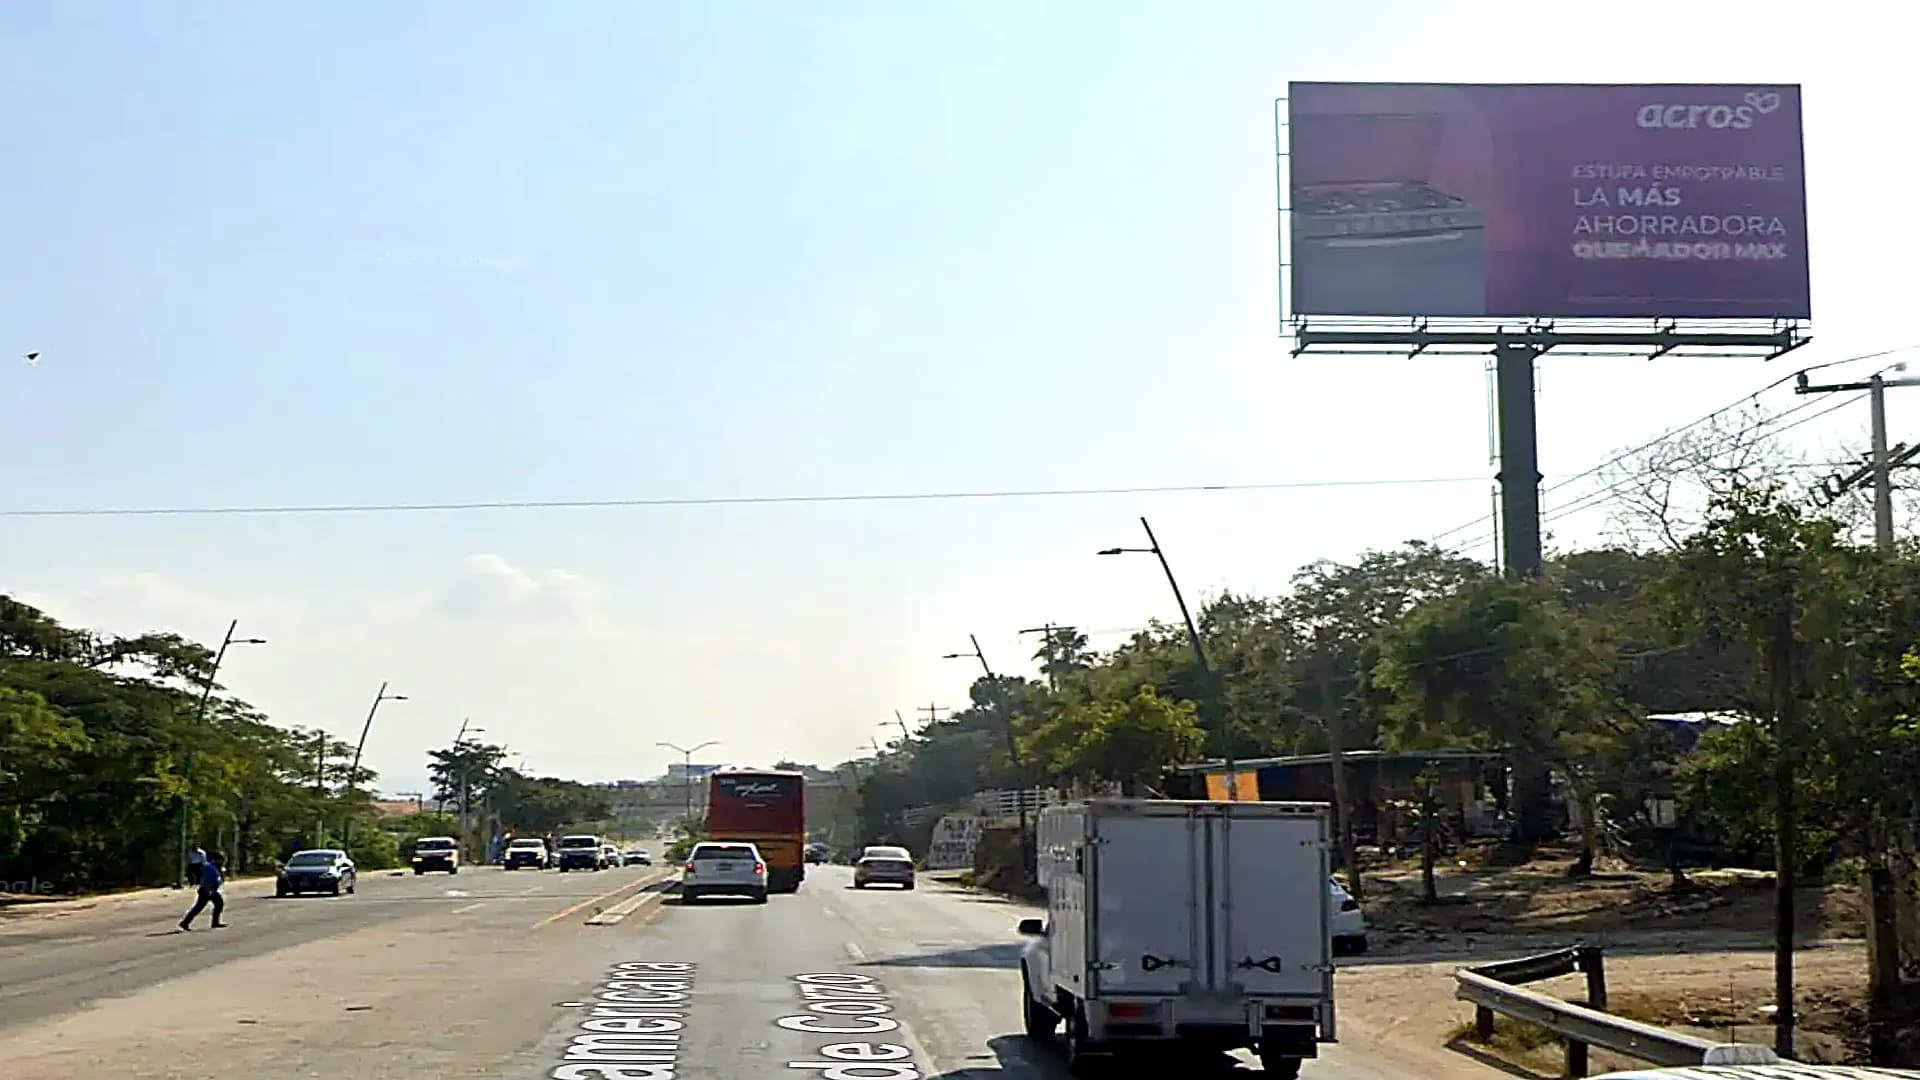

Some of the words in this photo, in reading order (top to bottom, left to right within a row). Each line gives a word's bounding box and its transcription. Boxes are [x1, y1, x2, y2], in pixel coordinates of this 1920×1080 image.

[1636, 104, 1753, 128] acros
[1572, 164, 1646, 180] ESTUFA
[1574, 187, 1610, 208] LA
[1618, 182, 1681, 207] MÁS
[1573, 214, 1786, 235] AHORRADORA
[1572, 240, 1732, 260] QUEMADOR
